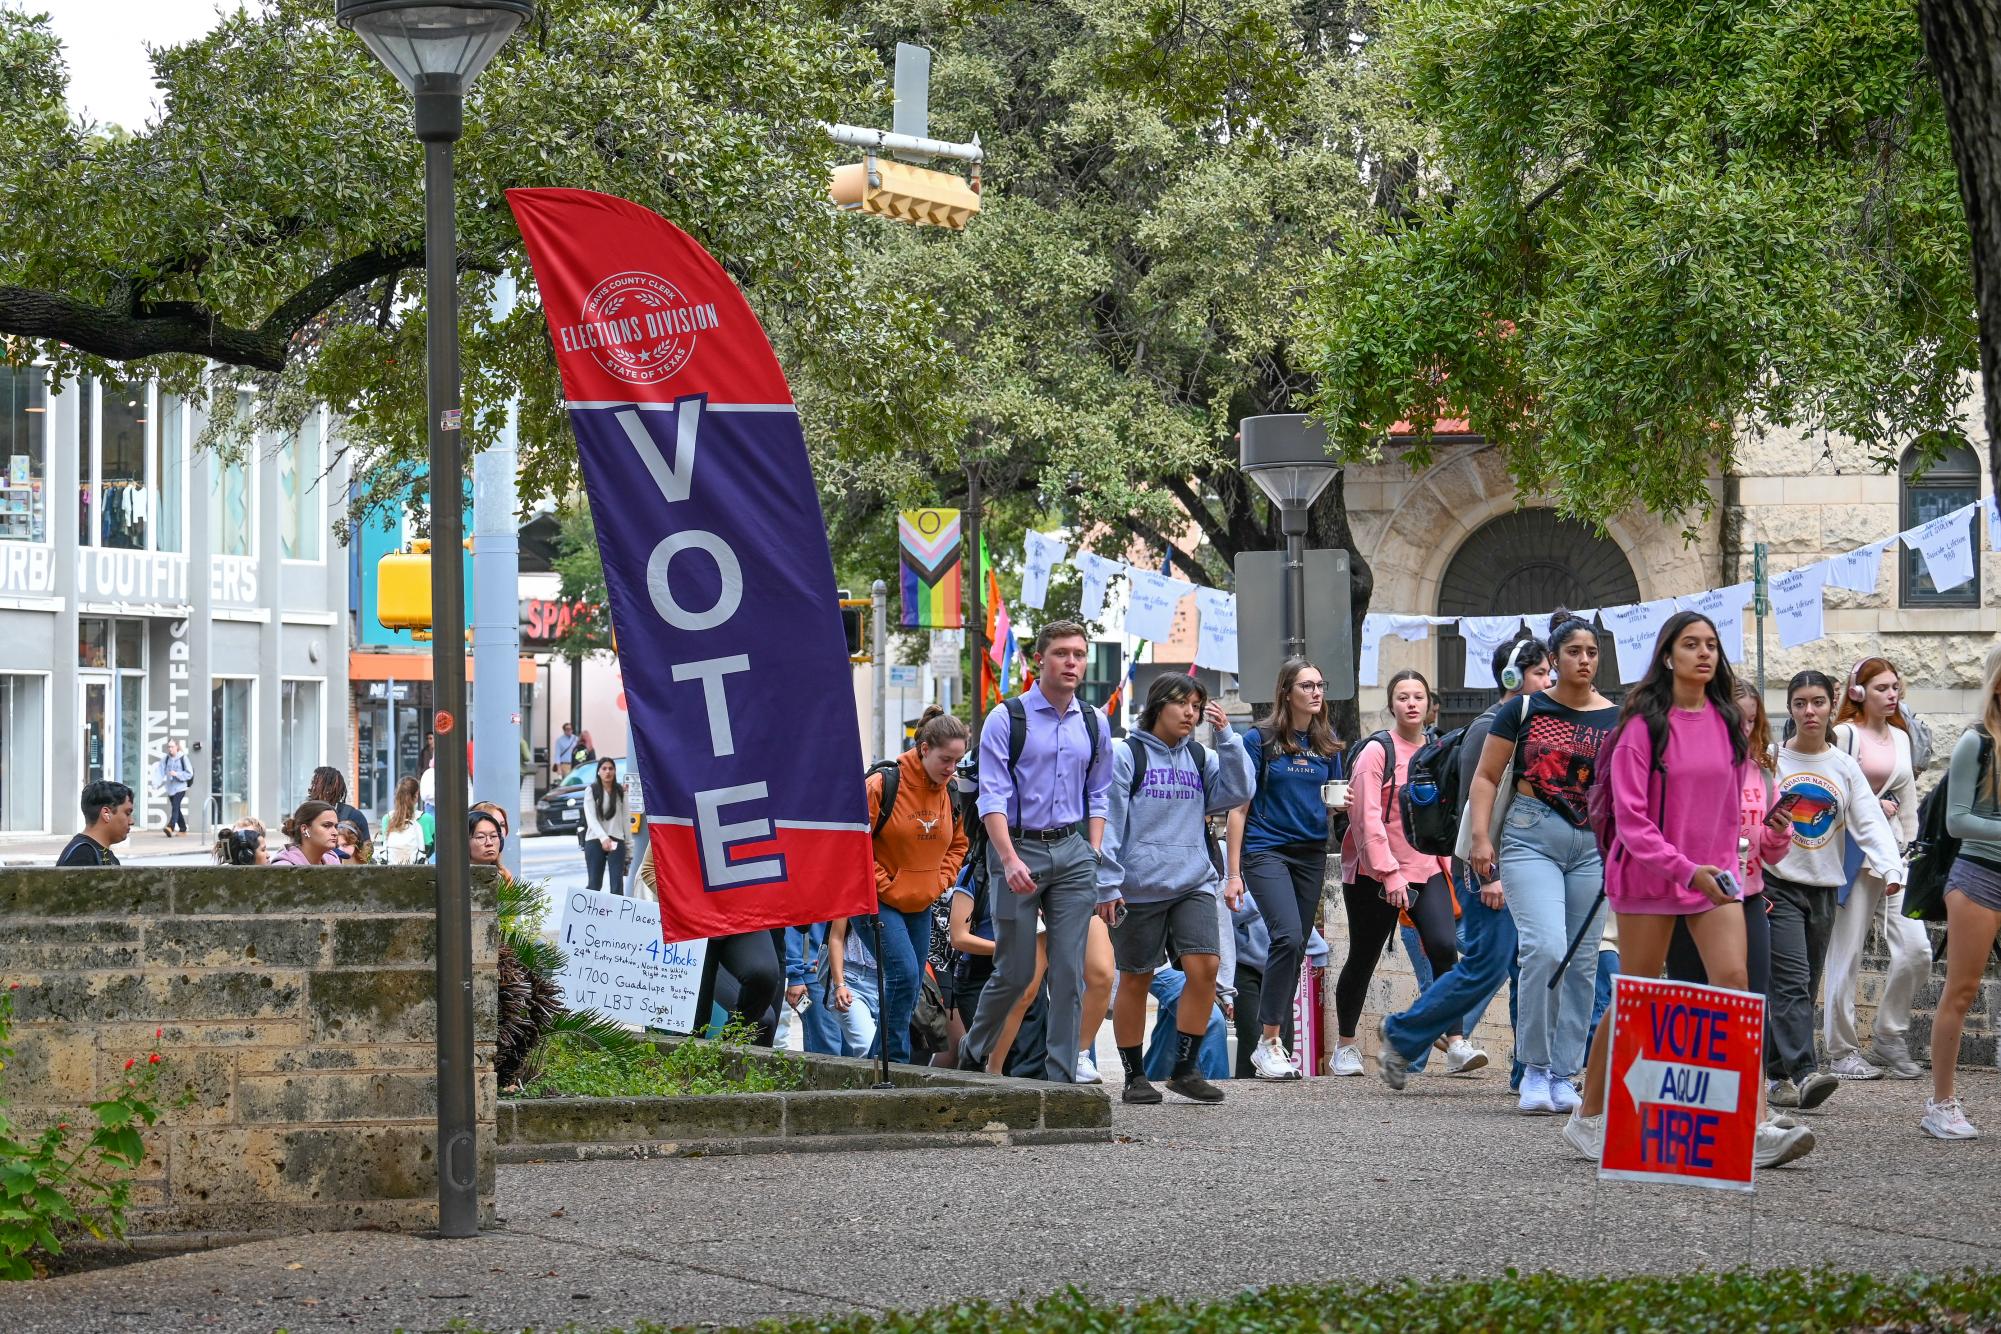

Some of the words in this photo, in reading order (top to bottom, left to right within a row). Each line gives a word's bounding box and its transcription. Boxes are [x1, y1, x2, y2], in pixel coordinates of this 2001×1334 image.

[588, 287, 609, 313] TRAVIS
[609, 277, 647, 290] COUNTY
[649, 280, 676, 300] CLERK
[560, 316, 643, 353] ELECTIONS
[646, 303, 719, 339] DIVISION
[607, 359, 637, 378] STATE
[640, 370, 655, 379] OF
[658, 347, 686, 374] TEXAS
[96, 553, 258, 602] OUTFITERS
[613, 397, 783, 889] VOTE
[148, 710, 168, 830] URAN
[1140, 768, 1175, 788] OSTA
[1287, 766, 1315, 774] MAINE
[1783, 776, 1811, 790] AVIATOR
[1812, 777, 1839, 797] NATION
[1145, 789, 1172, 799] PURA
[571, 893, 613, 917] Other
[620, 899, 656, 925] Places
[566, 923, 576, 945] 1.
[584, 924, 643, 956] Seminary:
[646, 939, 660, 961] 4
[662, 943, 697, 967] Blocks
[578, 966, 609, 985] 1700
[615, 975, 665, 995] Guadalupe
[576, 989, 597, 1005] UT
[604, 993, 634, 1010] LBJ
[1650, 1002, 1728, 1063] VOTE
[1659, 1066, 1711, 1105] AQUI
[1640, 1108, 1719, 1168] HERE
